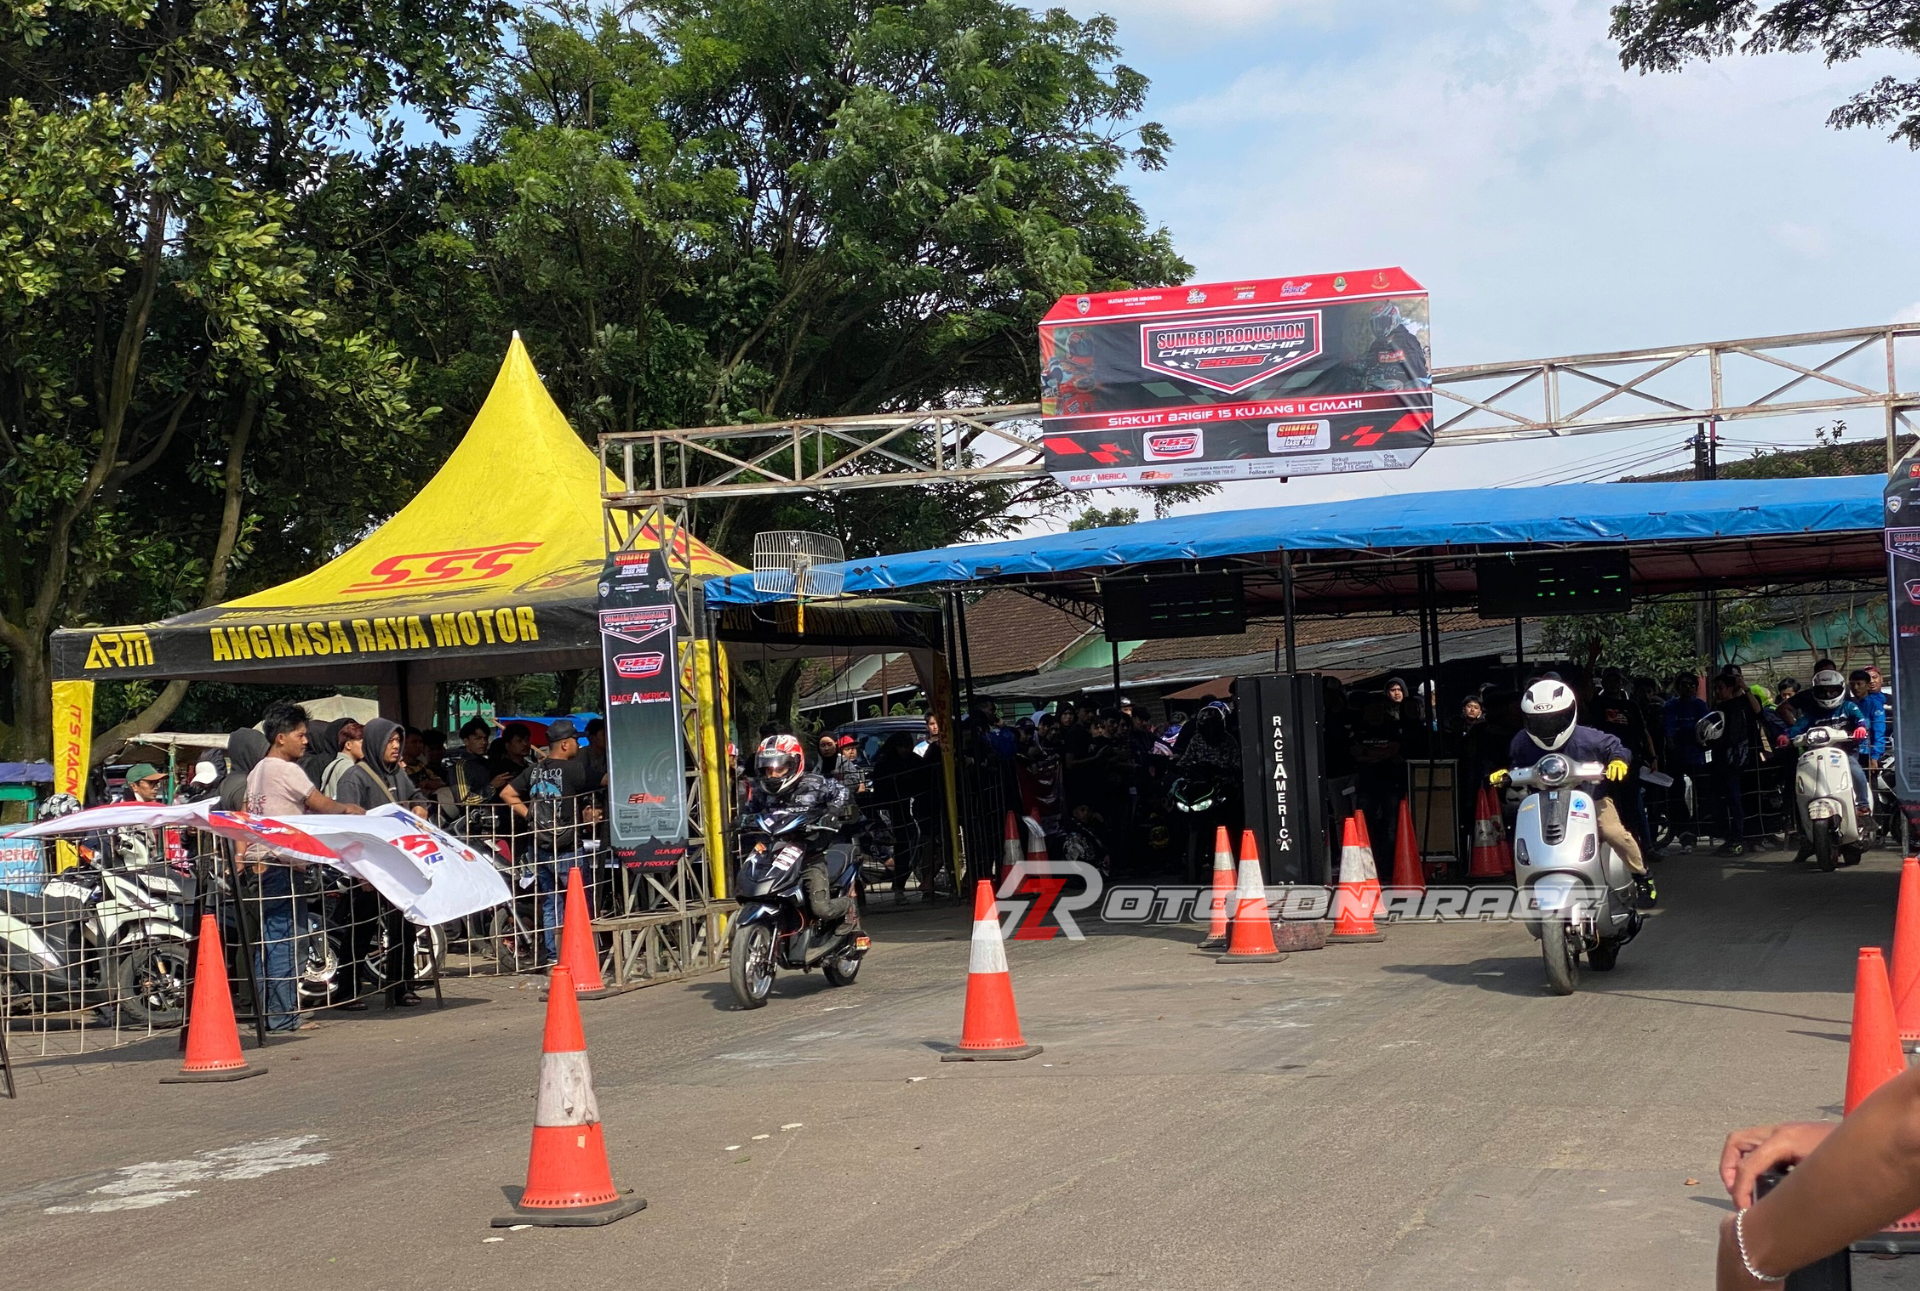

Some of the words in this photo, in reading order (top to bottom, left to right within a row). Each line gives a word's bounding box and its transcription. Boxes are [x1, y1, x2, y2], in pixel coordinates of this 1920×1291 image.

[1157, 329, 1214, 349] SUMBER
[1216, 323, 1305, 345] PRODUCTION
[1158, 339, 1305, 358] CHAMPIONSHIP
[1108, 414, 1163, 427] SIRKUIT
[1168, 410, 1214, 422] BRIGIF
[1217, 409, 1232, 419] 15
[1236, 405, 1294, 417] KUJANG
[1309, 400, 1363, 411] CIMAHI
[1277, 423, 1319, 438] SUMBER
[1070, 472, 1127, 484] RACEAMERICA
[615, 552, 651, 566] SUMBER
[210, 620, 352, 662] ANGKASA
[352, 615, 430, 652] RAYA
[430, 606, 539, 648] MOTOR
[84, 632, 155, 669] ARM
[611, 691, 670, 705] RACEAMERICA
[65, 743, 81, 796] RACIN
[1273, 715, 1290, 852] RACEAMERICA
